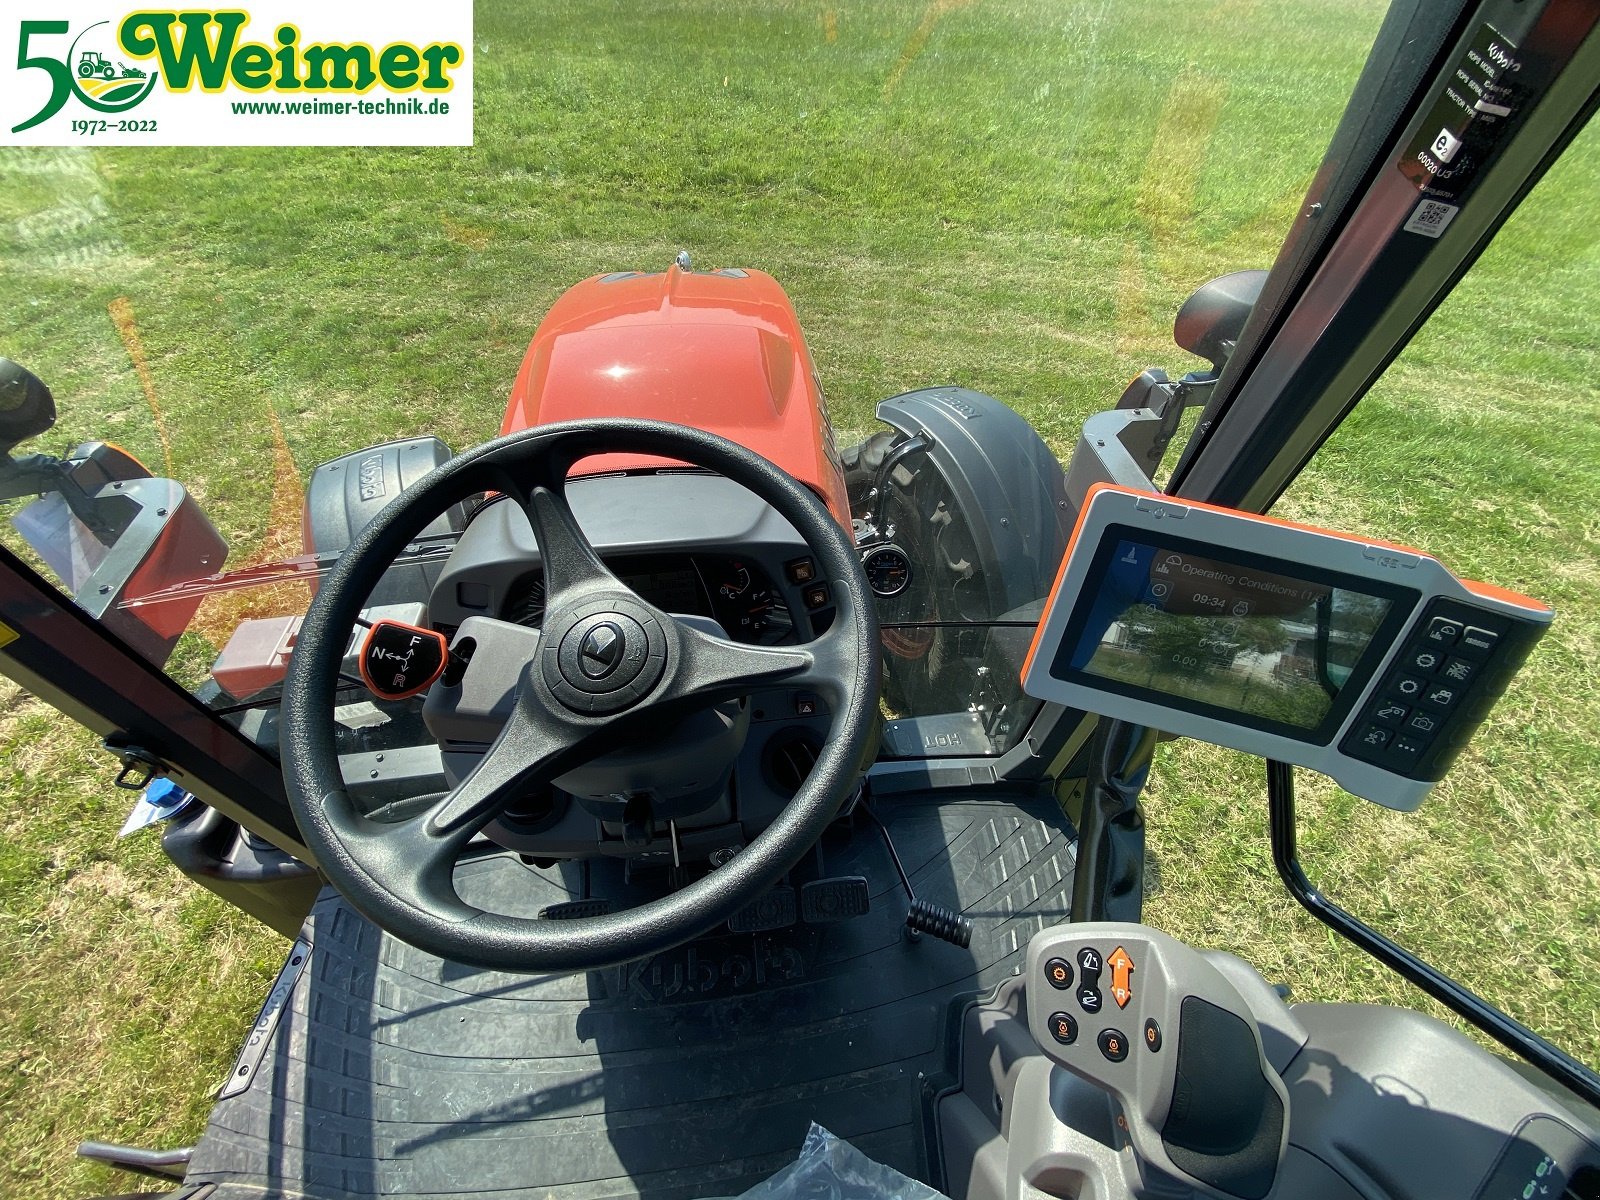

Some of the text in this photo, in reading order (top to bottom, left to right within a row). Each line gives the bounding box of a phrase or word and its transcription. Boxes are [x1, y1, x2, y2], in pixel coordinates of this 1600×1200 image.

[1487, 42, 1522, 73] Kubota
[1445, 87, 1466, 109] TRACTOR
[1181, 560, 1236, 587] Operating
[1237, 573, 1298, 600] Conditions
[1191, 592, 1227, 611] 09:34
[409, 635, 422, 647] F
[371, 647, 385, 660] N
[393, 674, 404, 687] R
[924, 732, 963, 750] HOT
[618, 938, 804, 1001] Kubota
[1116, 958, 1126, 970] F
[1116, 987, 1126, 999] R
[249, 982, 291, 1047] Kubota
